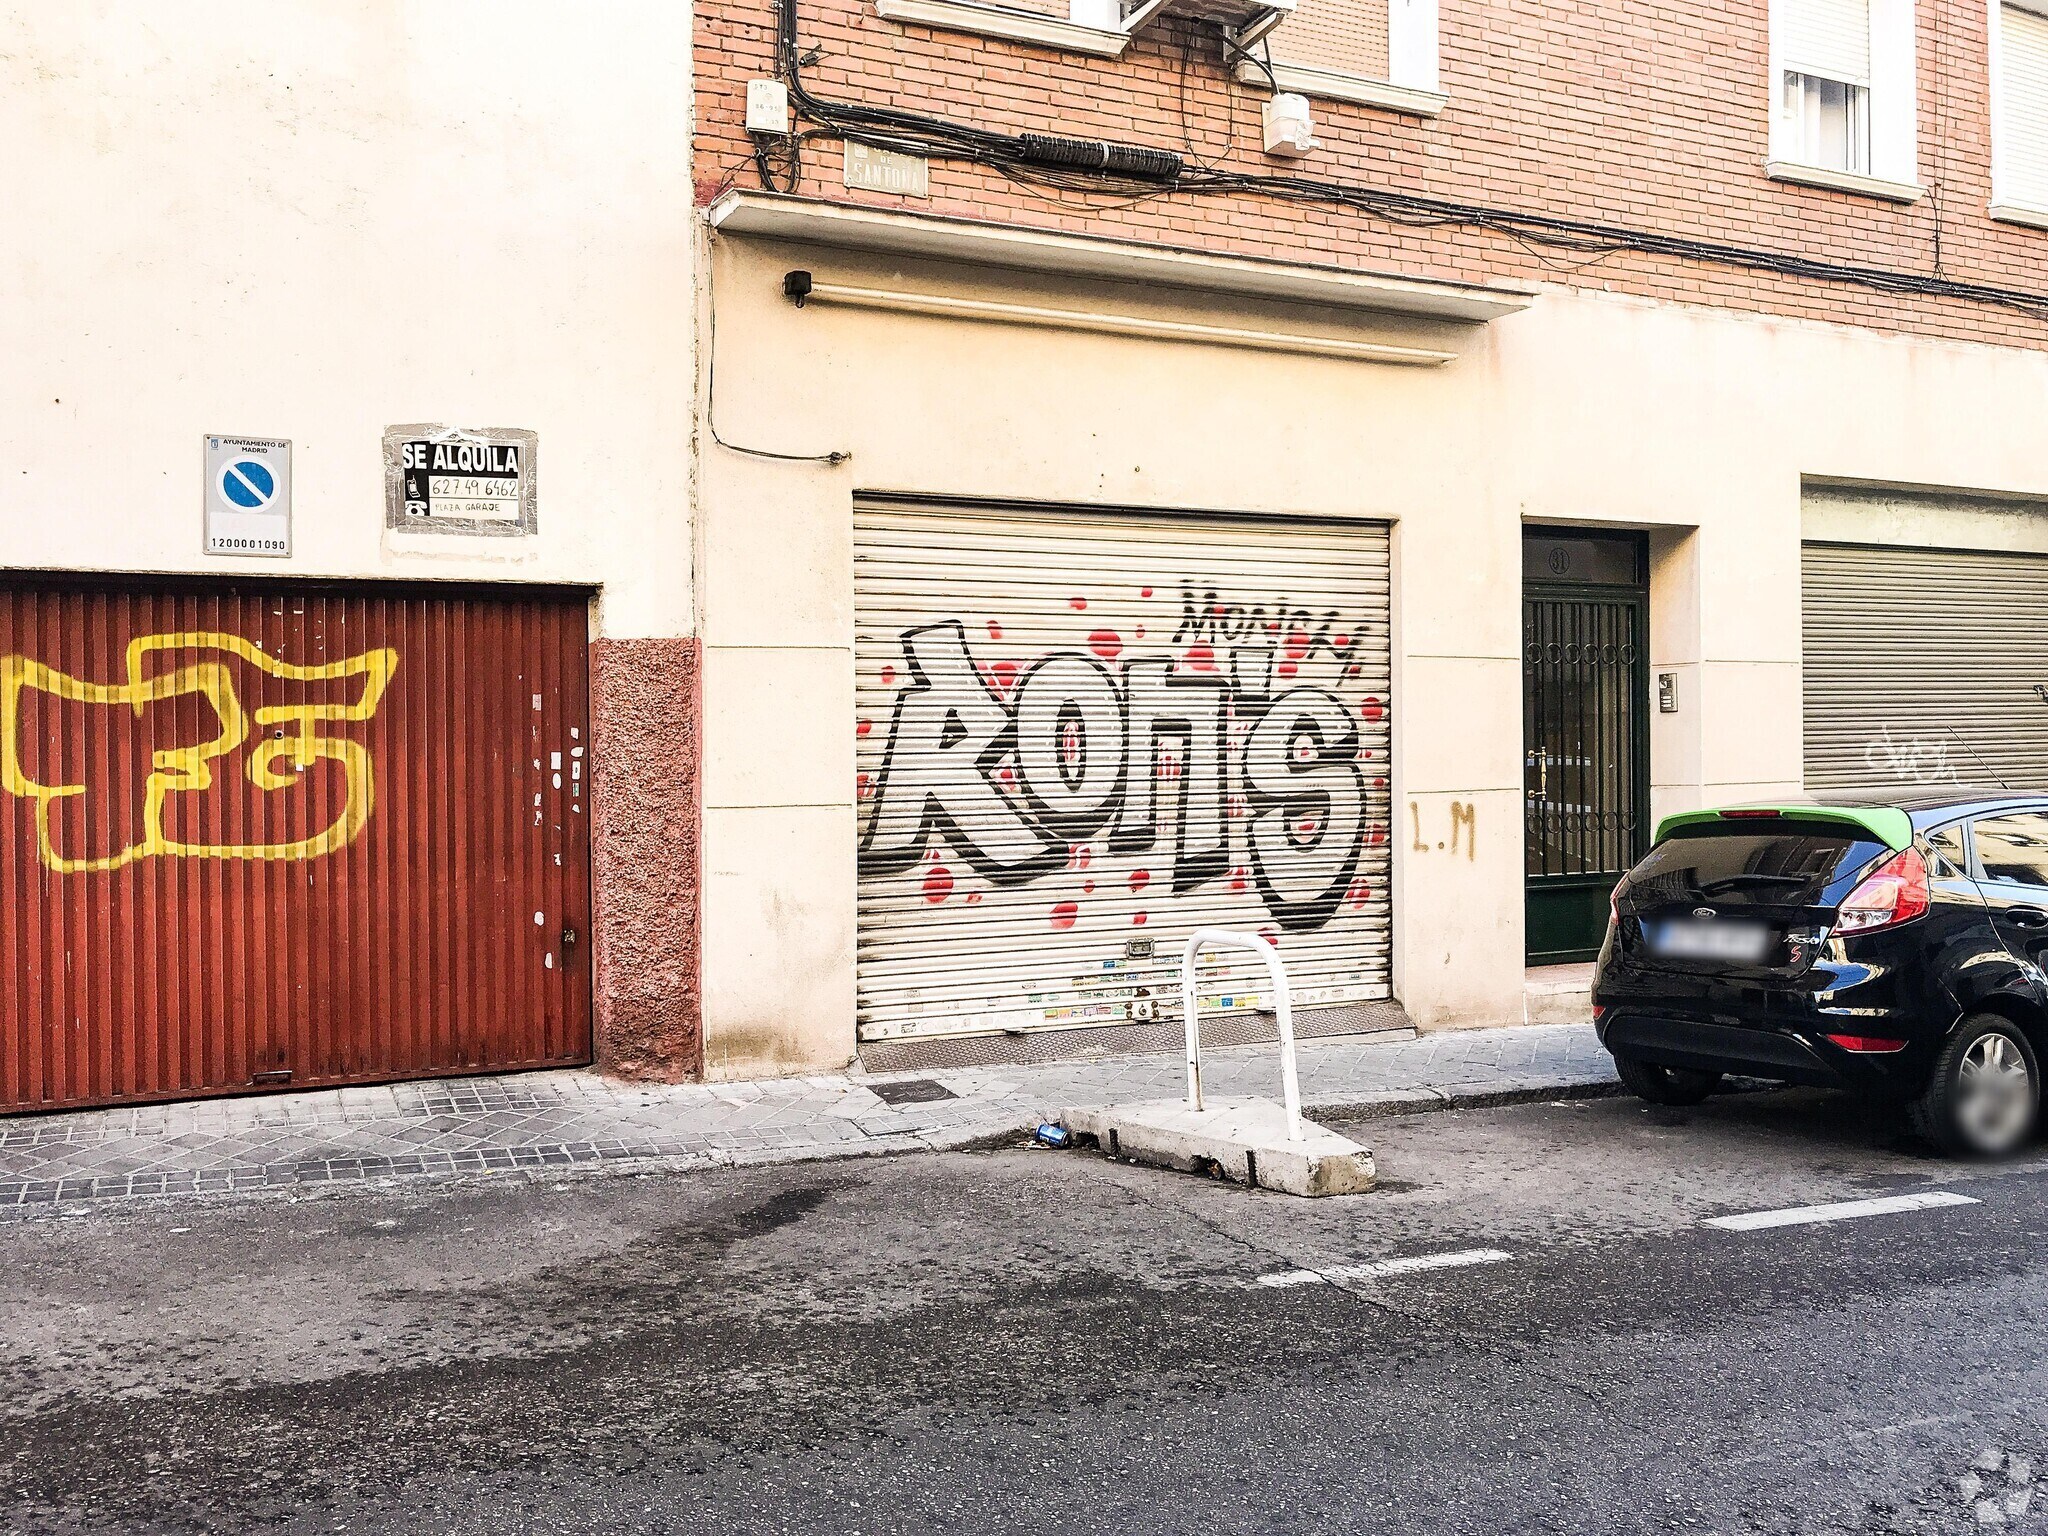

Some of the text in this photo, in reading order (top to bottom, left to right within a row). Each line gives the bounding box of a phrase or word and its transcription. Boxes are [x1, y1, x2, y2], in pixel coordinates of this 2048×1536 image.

[880, 155, 892, 164] DE
[223, 439, 276, 448] AYUNTAMIENTO
[241, 446, 268, 454] MADRID
[401, 443, 518, 473] SE ALQUILA
[435, 503, 501, 512] PLAZA GARAJE
[212, 538, 285, 550] 1200001090
